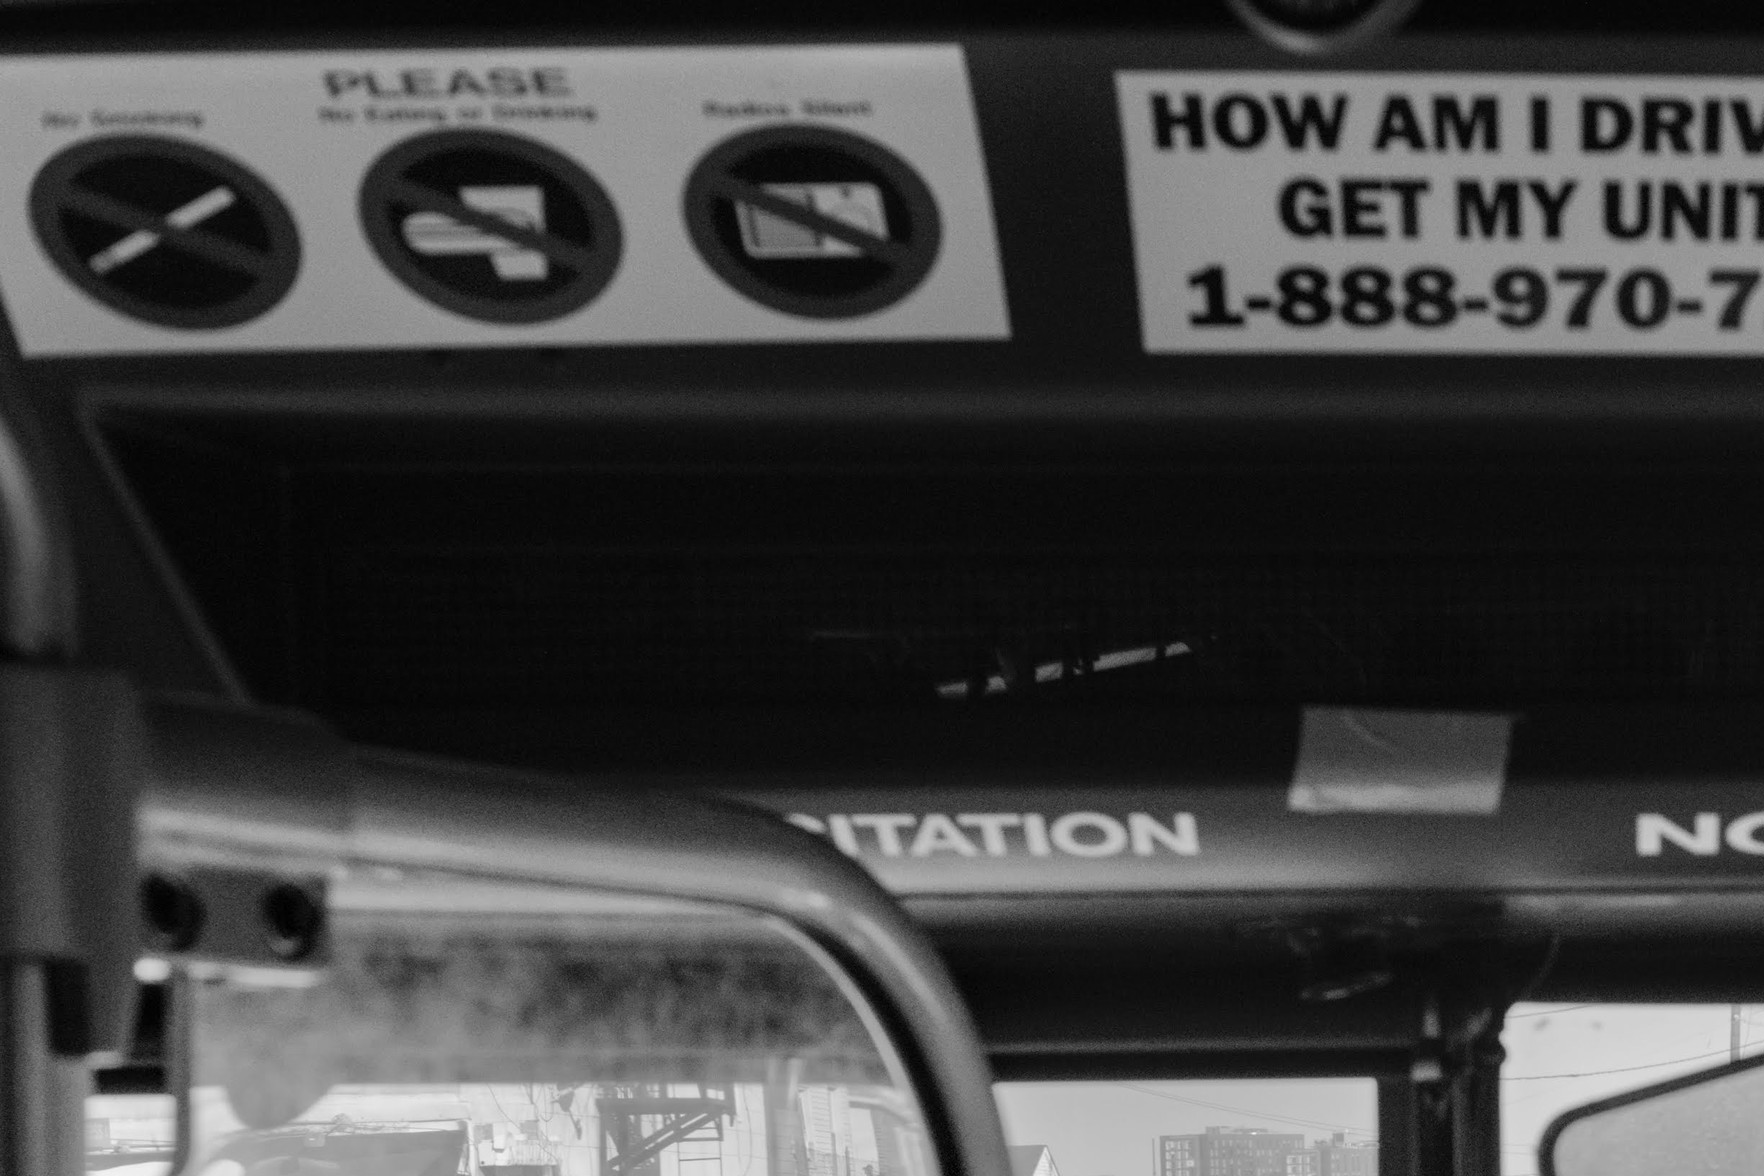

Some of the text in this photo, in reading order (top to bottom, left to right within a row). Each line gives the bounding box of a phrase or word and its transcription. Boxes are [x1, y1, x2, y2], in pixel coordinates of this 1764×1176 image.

[322, 67, 575, 98] PLEASE
[1152, 94, 1347, 151] HOW
[1374, 95, 1500, 152] AM
[1530, 96, 1549, 152] I
[1277, 177, 1428, 239] GET
[1455, 179, 1577, 240] MY
[785, 811, 1200, 858] ITATION
